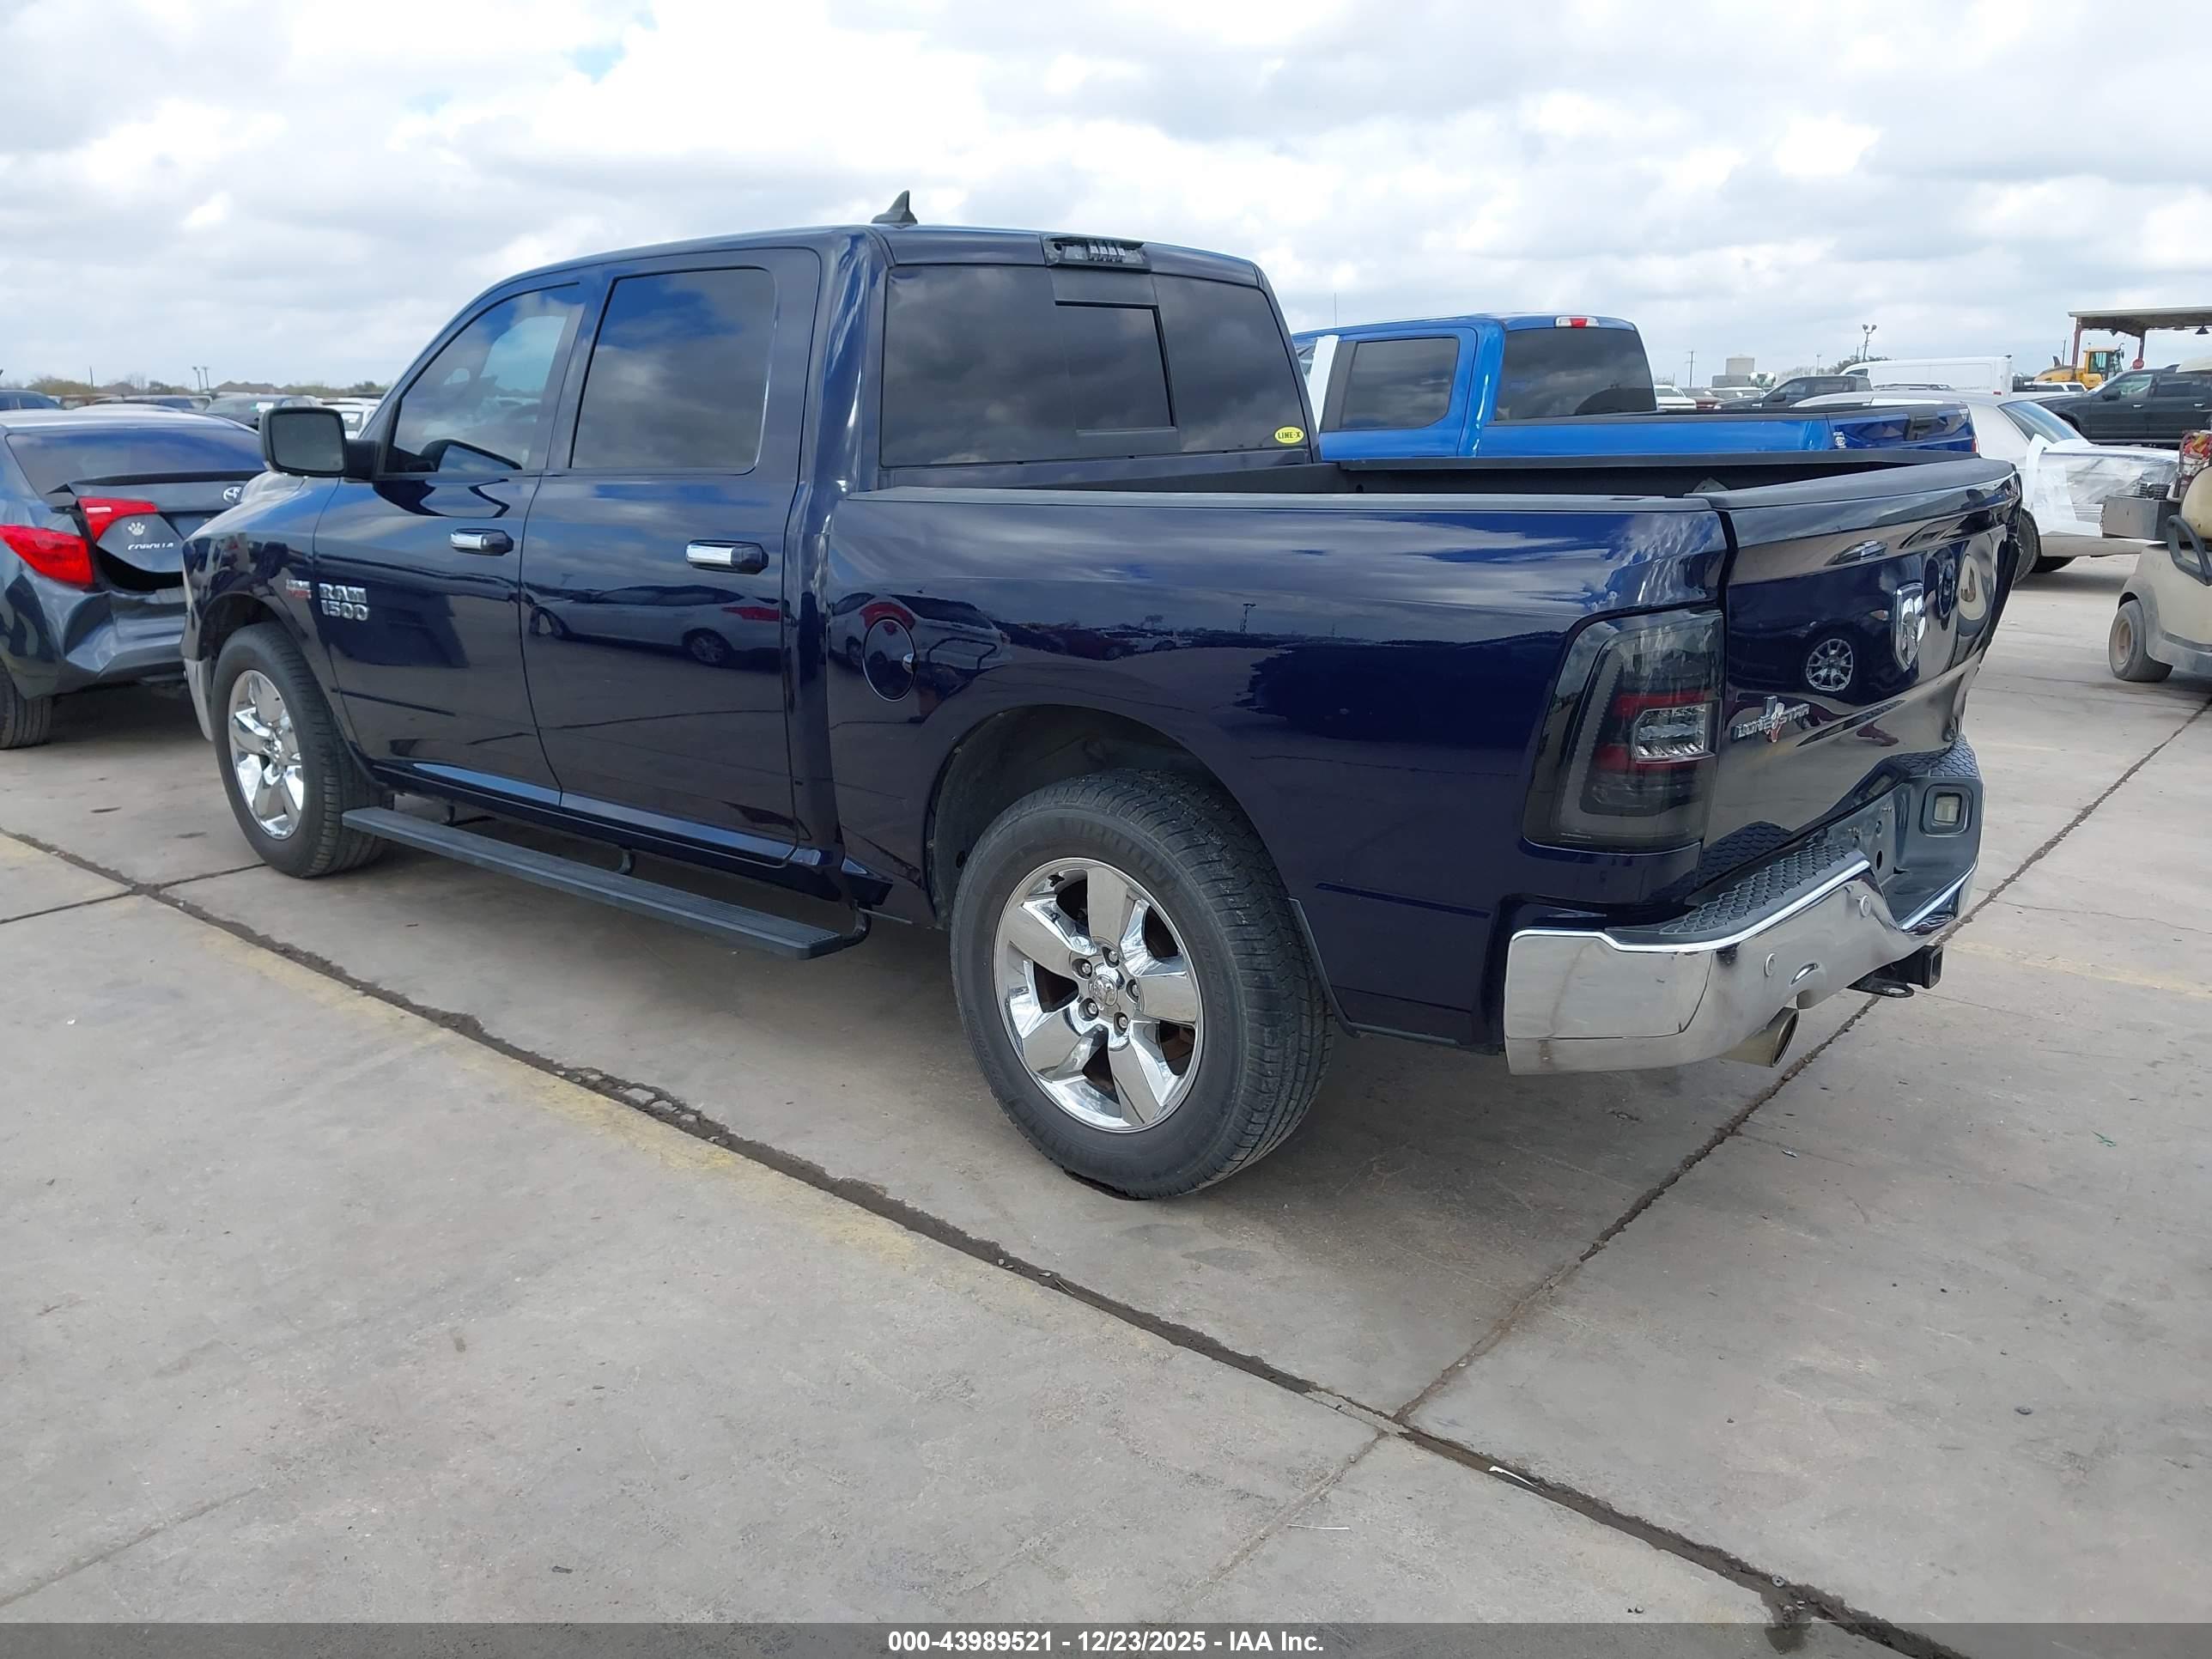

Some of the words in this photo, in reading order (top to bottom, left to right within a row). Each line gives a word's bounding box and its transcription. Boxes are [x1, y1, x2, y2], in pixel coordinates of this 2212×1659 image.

[319, 582, 368, 603] RAM
[320, 599, 369, 621] 1500
[1731, 714, 1772, 741] LONE
